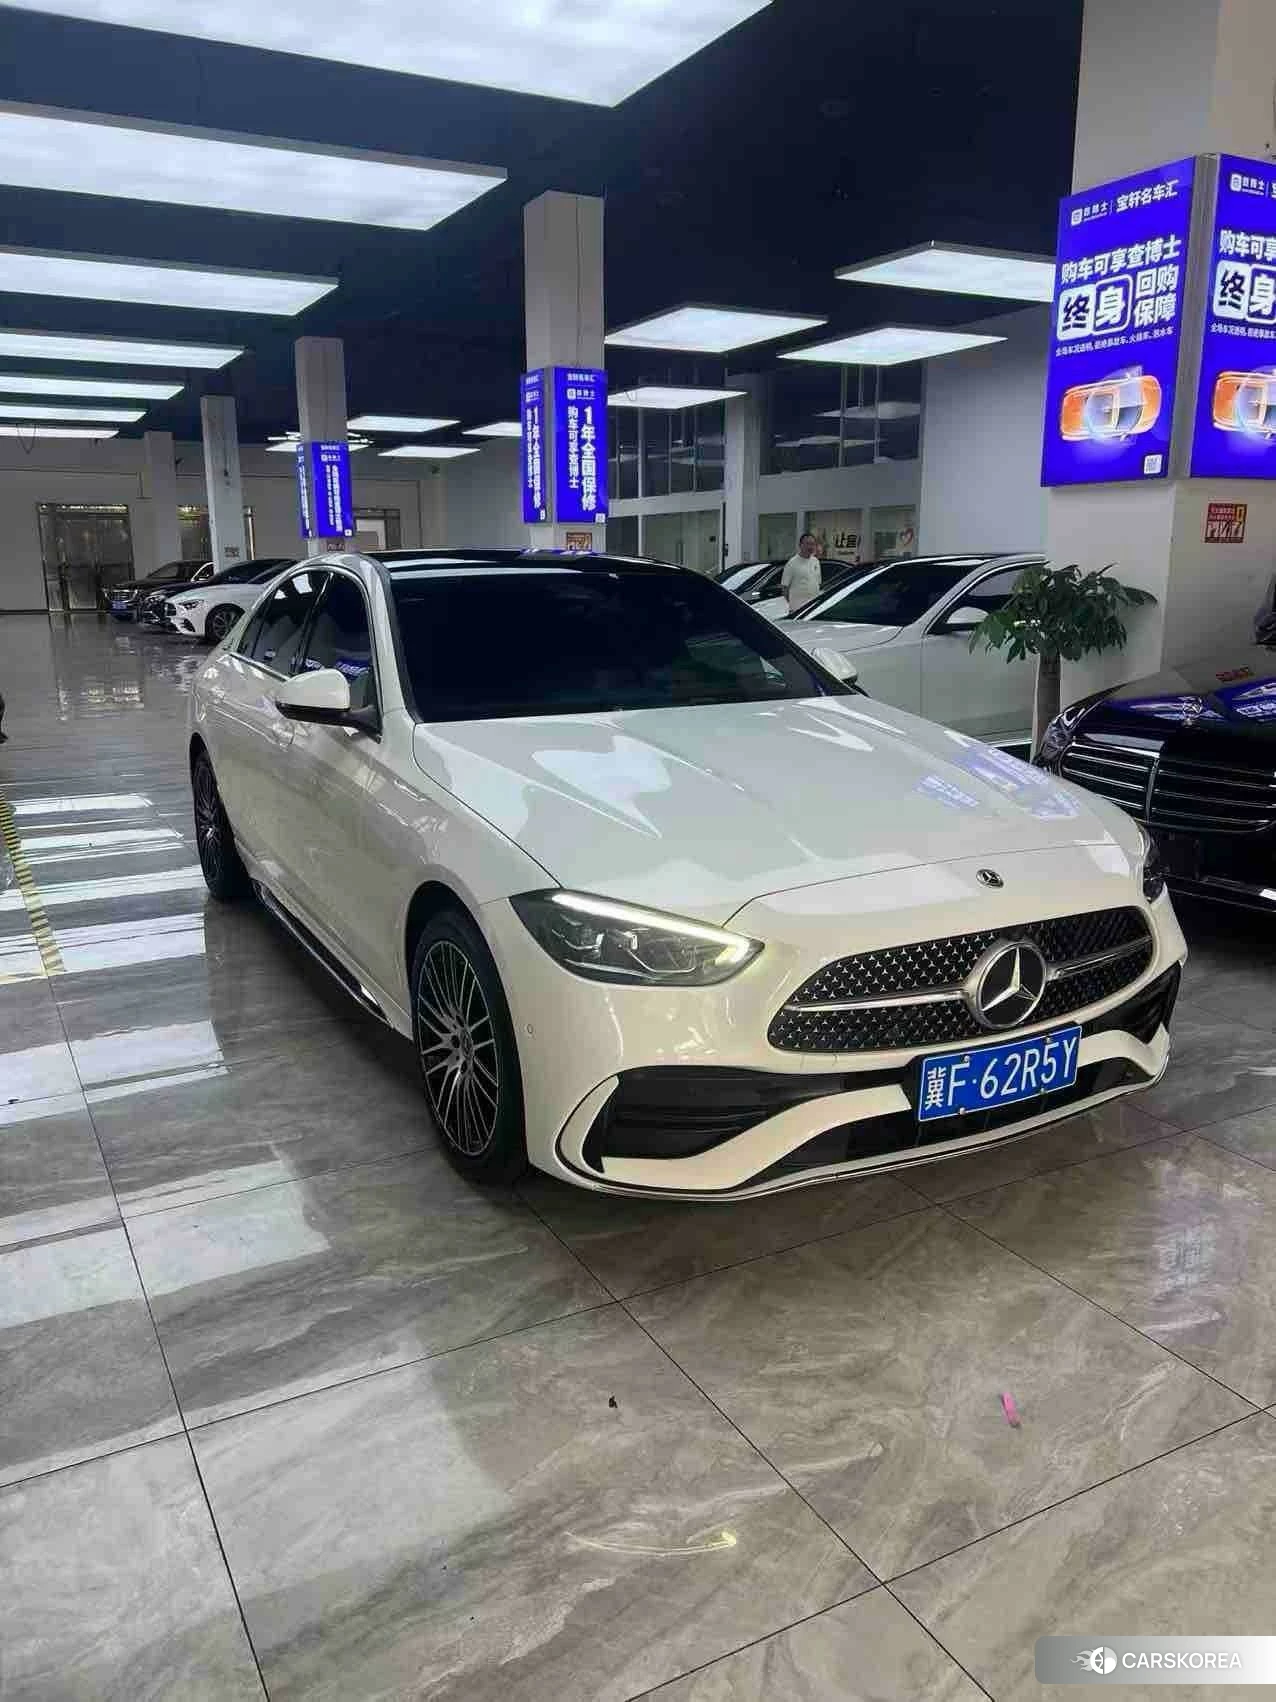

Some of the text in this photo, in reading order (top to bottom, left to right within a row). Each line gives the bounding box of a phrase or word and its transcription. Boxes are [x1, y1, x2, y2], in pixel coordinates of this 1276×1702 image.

[1116, 179, 1179, 212] 宝轩名车汇
[1062, 234, 1181, 284] 购车可享查博士
[1136, 263, 1179, 299] 回购
[1218, 269, 1275, 315] 终身
[1061, 285, 1126, 332] 终身
[1133, 293, 1177, 328] 保障
